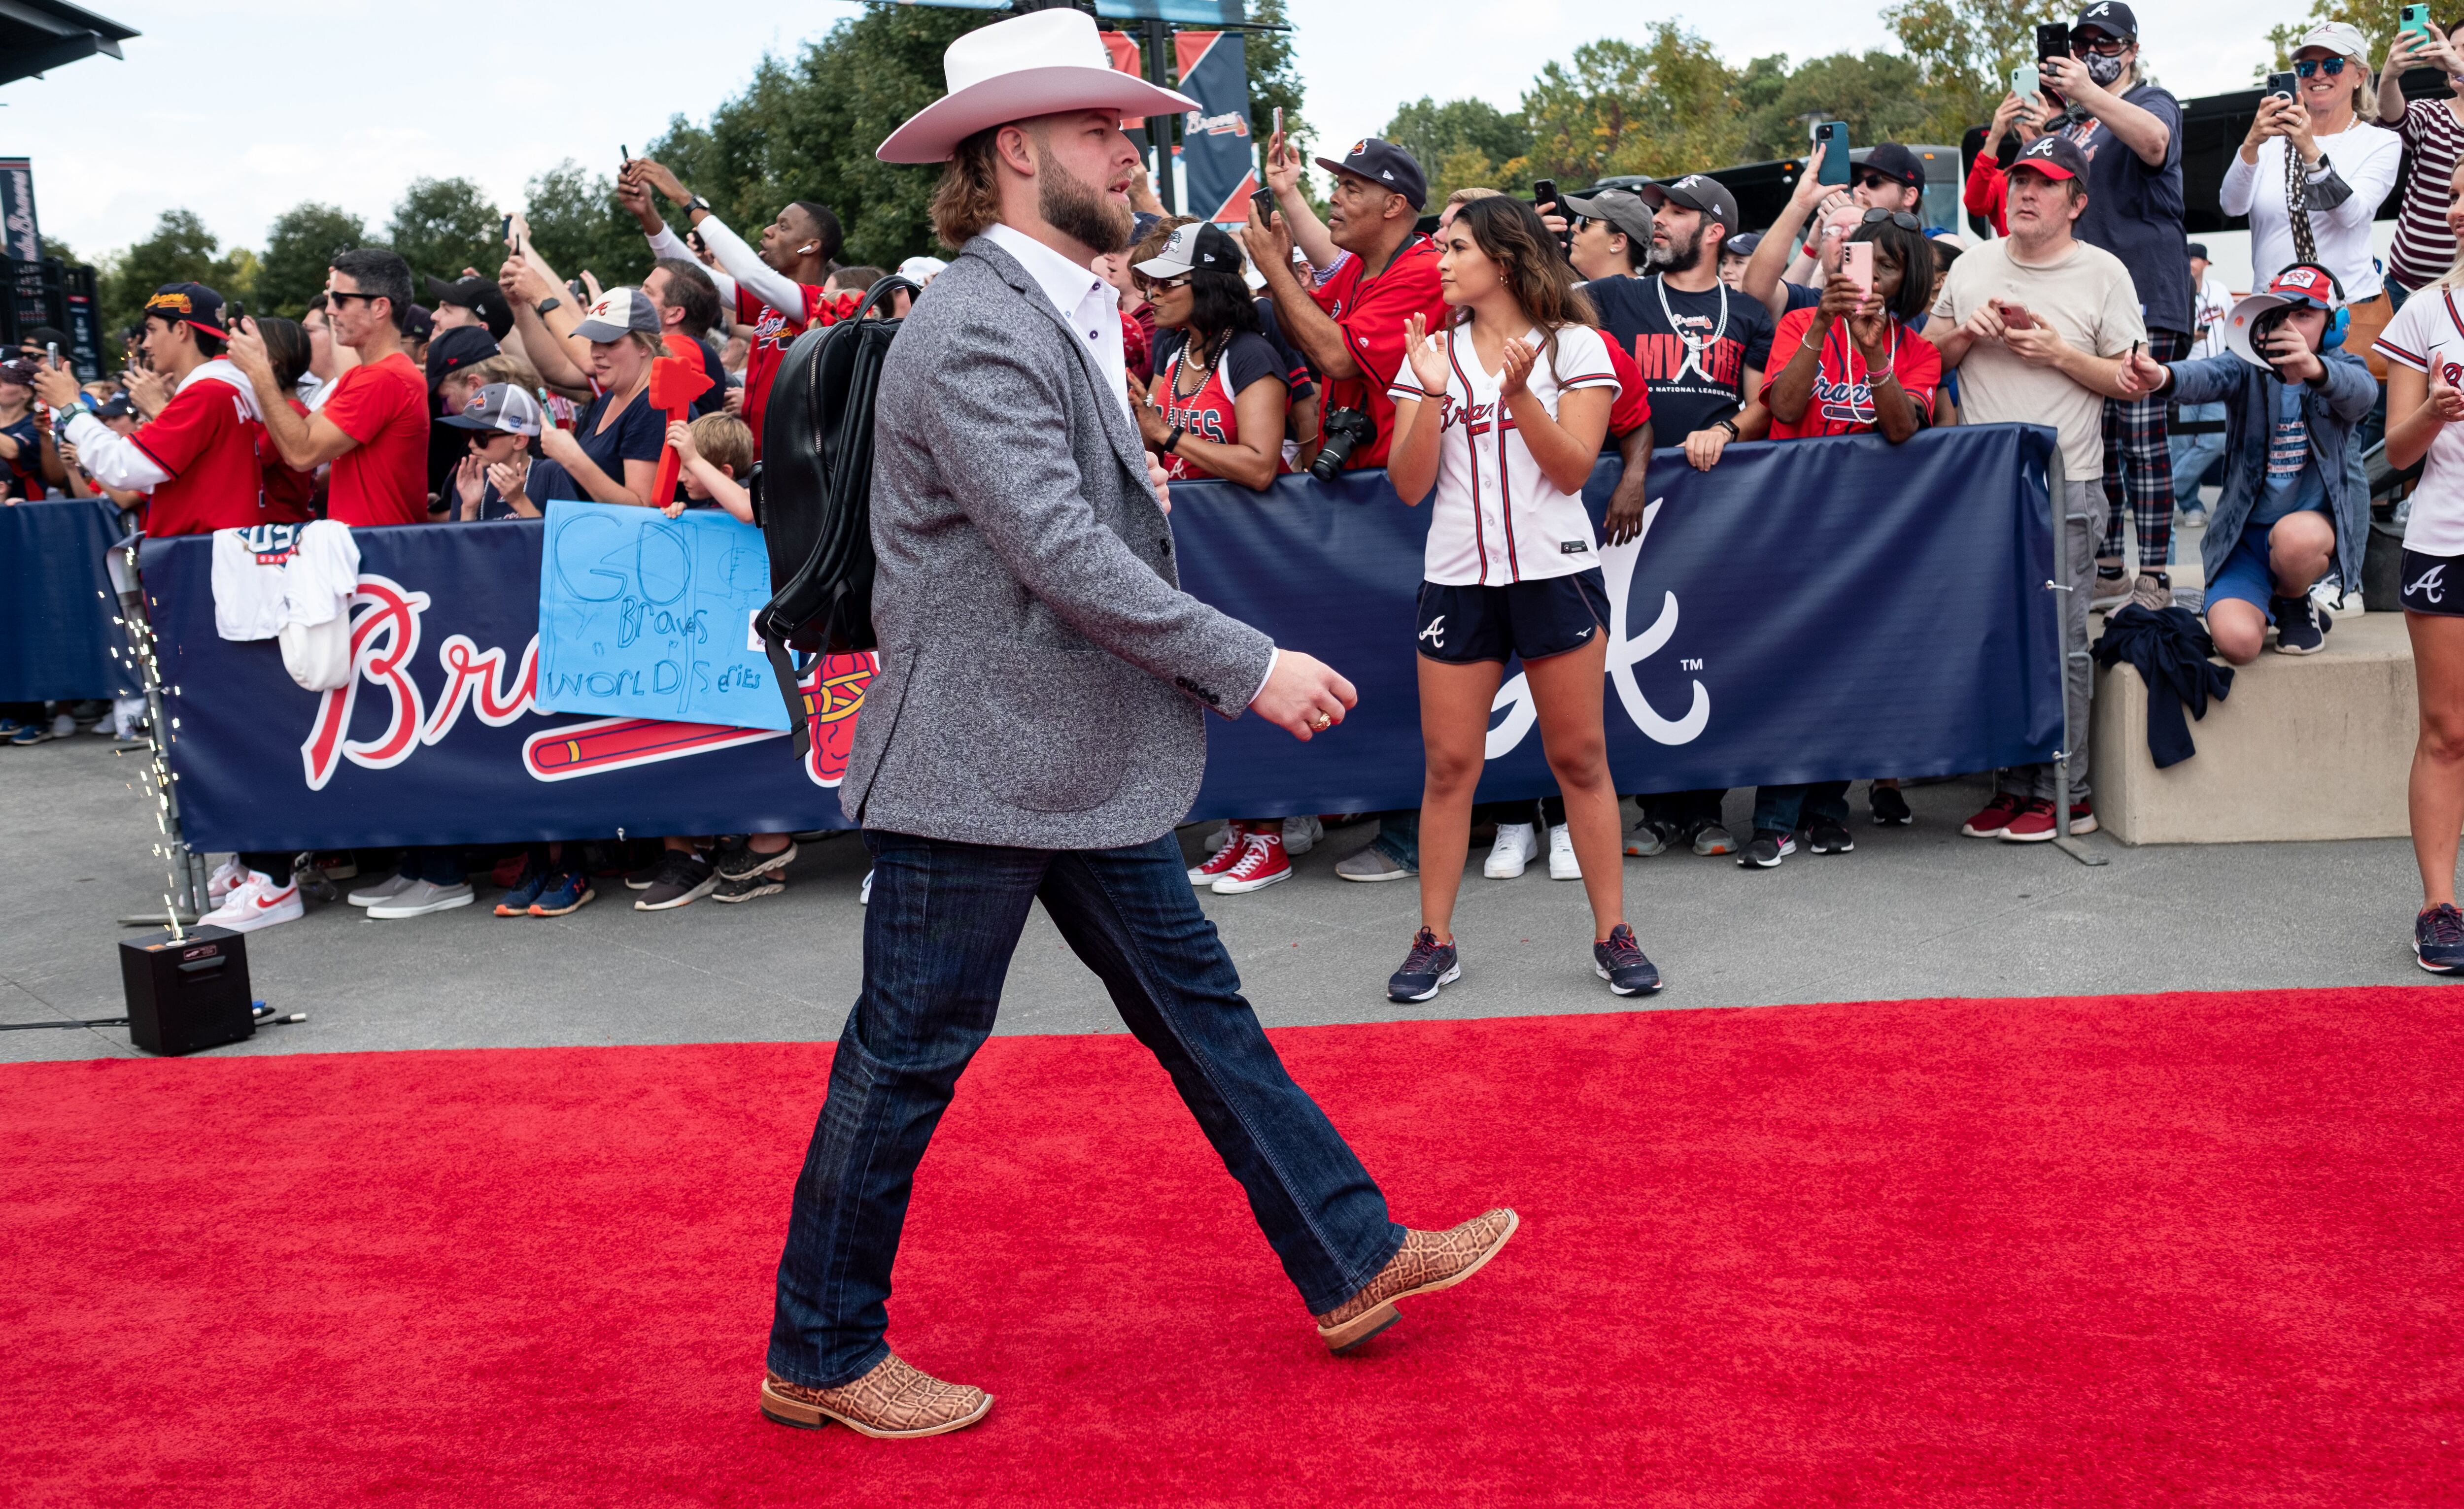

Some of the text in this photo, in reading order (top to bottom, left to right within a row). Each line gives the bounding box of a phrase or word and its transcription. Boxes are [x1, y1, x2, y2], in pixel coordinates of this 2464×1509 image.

[2026, 137, 2054, 156] A
[589, 301, 611, 316] A
[555, 511, 690, 606] GO
[2404, 564, 2446, 604] A
[1419, 615, 1445, 648] A
[1680, 658, 1703, 671] TM
